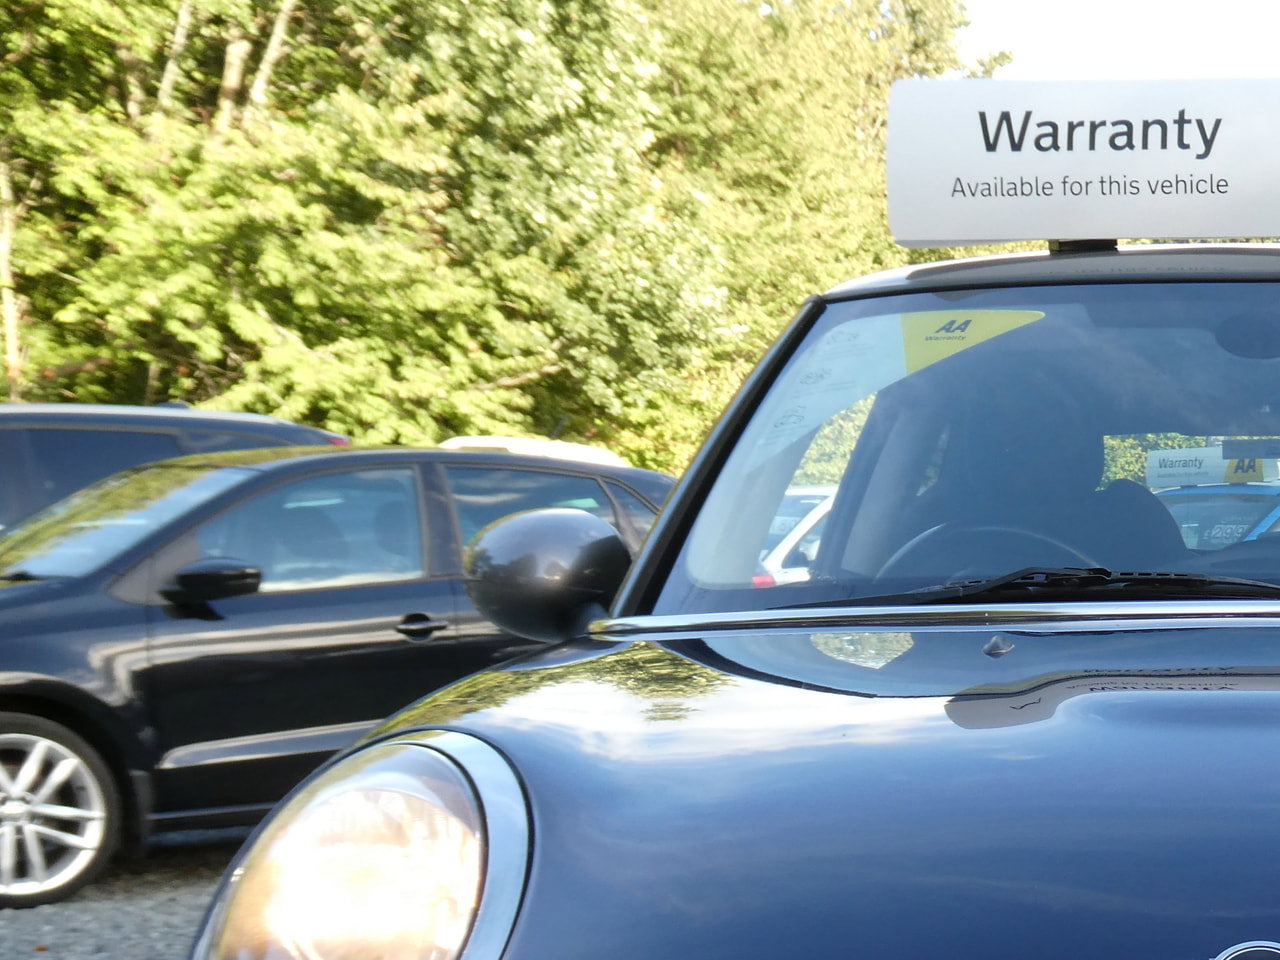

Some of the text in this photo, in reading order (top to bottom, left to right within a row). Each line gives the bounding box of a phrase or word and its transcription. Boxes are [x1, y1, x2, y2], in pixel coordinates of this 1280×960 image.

[978, 108, 1222, 160] Warranty
[952, 173, 1229, 198] Available for this vehicle
[934, 319, 973, 333] AA
[1158, 458, 1204, 470] Warranty
